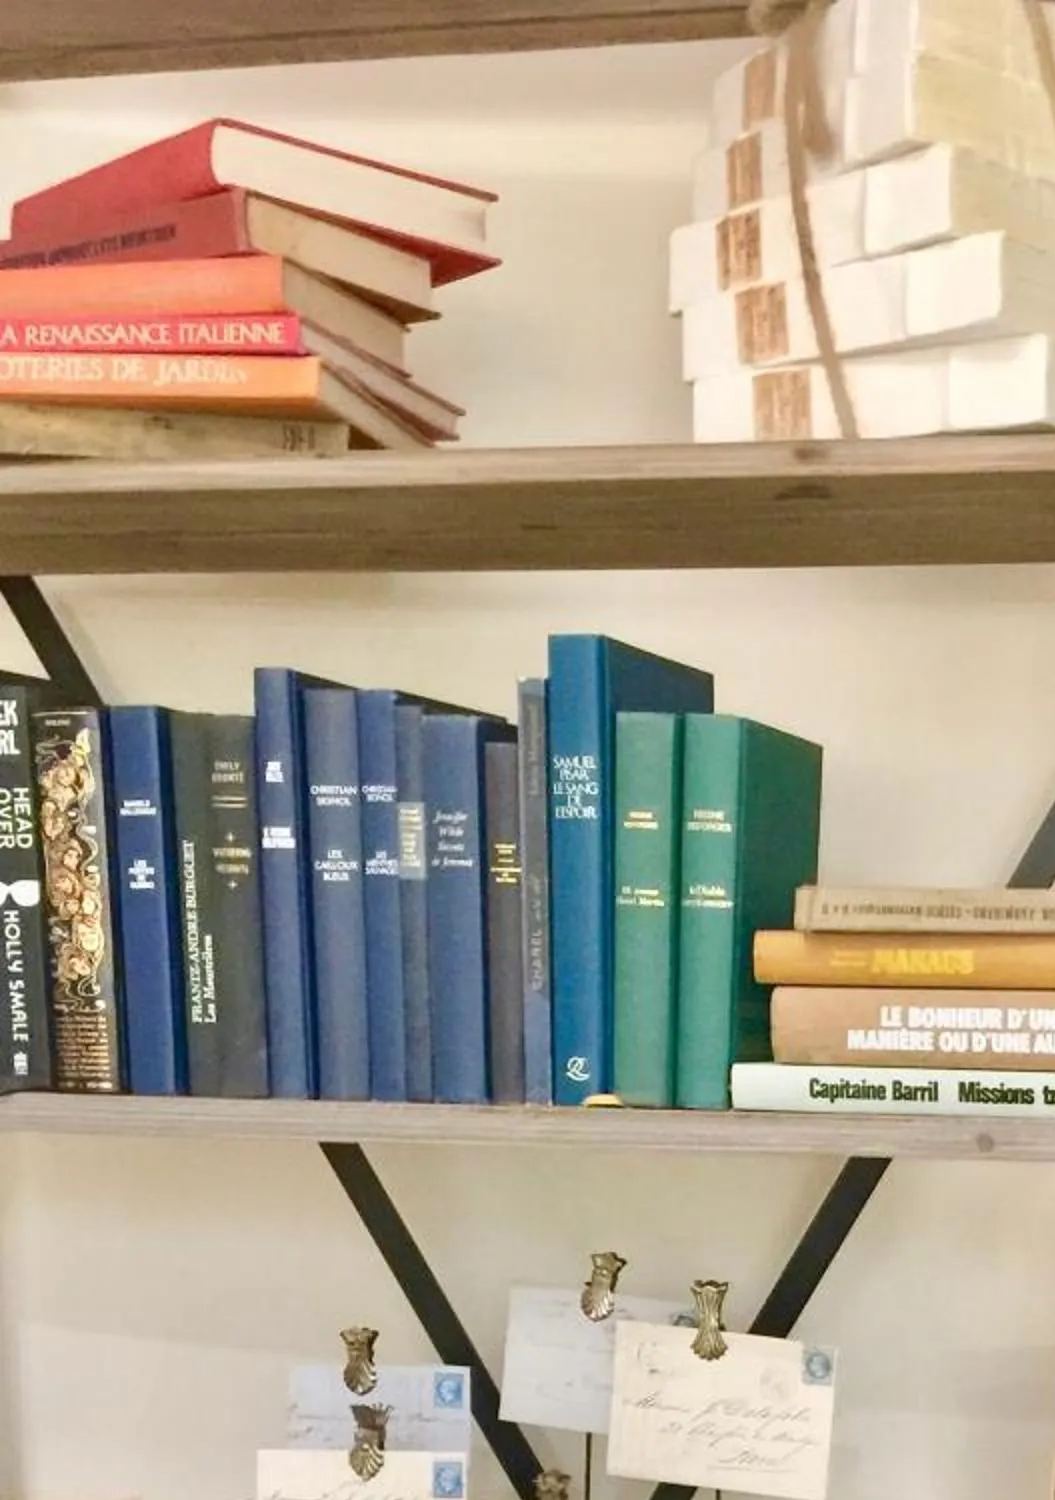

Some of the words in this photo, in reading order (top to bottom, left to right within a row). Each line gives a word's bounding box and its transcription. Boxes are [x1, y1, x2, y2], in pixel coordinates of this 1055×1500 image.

[0, 324, 17, 345] A
[25, 324, 170, 346] RENAISSANCE
[179, 323, 285, 344] ITALIENNE
[0, 355, 103, 381] OTERIES
[112, 356, 147, 382] DE
[0, 730, 21, 755] RL
[553, 755, 597, 769] SAMUEL
[0, 787, 15, 849] OVER
[13, 787, 33, 849] HEAD
[4, 909, 24, 973] HOLLY
[532, 929, 543, 991] CHANEL
[9, 979, 29, 1042] SMALE
[880, 1005, 902, 1028] LE
[908, 1007, 1003, 1030] BONHEUR
[847, 1028, 935, 1051] MANIÈRE
[939, 1031, 969, 1052] OU
[972, 1031, 1031, 1053] D'UNE
[809, 1077, 887, 1103] Capitaine
[892, 1080, 939, 1102] Barril
[958, 1081, 1035, 1104] Missions
